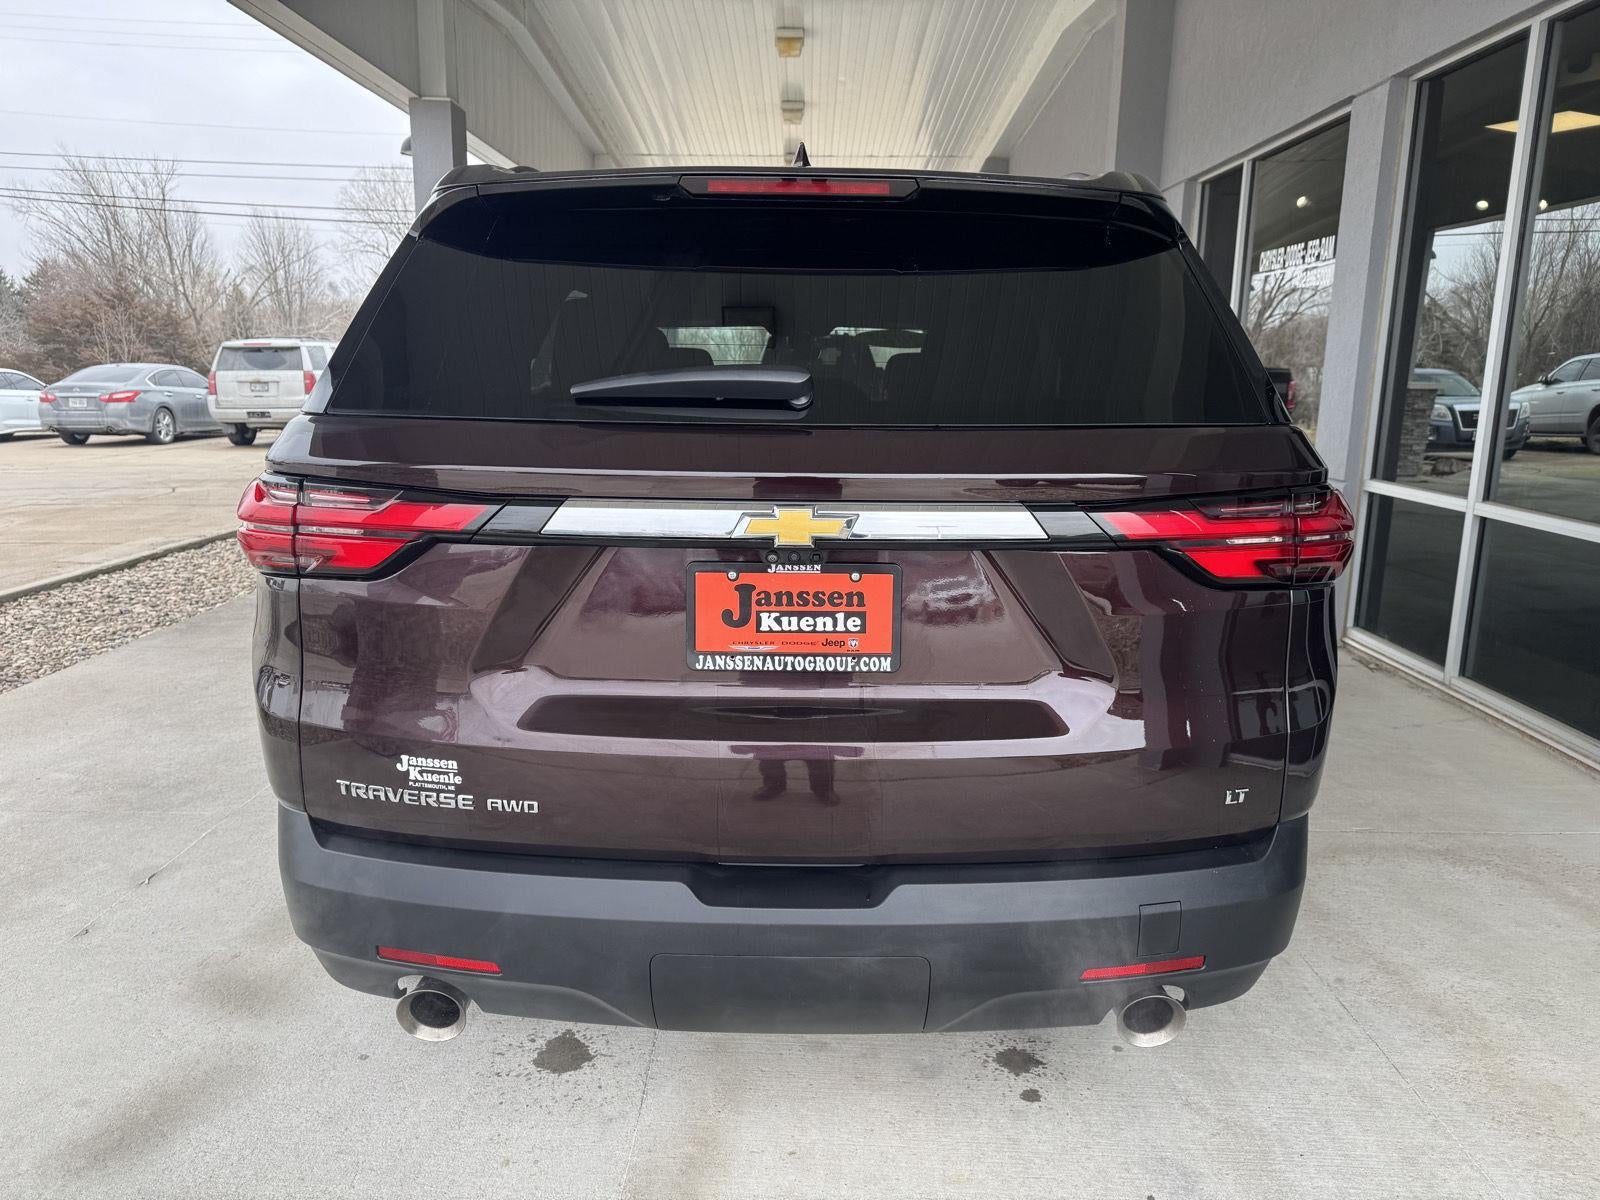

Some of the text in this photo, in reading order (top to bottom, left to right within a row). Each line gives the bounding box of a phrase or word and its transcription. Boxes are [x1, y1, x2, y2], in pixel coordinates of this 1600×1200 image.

[768, 564, 821, 573] JANSSEN
[721, 583, 866, 628] Janssen
[759, 612, 861, 632] Kuenle
[821, 638, 845, 648] Jeep
[695, 655, 892, 672] JANSSENAUTOGROUP.COM
[396, 755, 458, 772] Janssen
[408, 767, 463, 785] Kuenle
[336, 779, 539, 814] TRAVERSE AWD
[1225, 788, 1250, 805] LT
